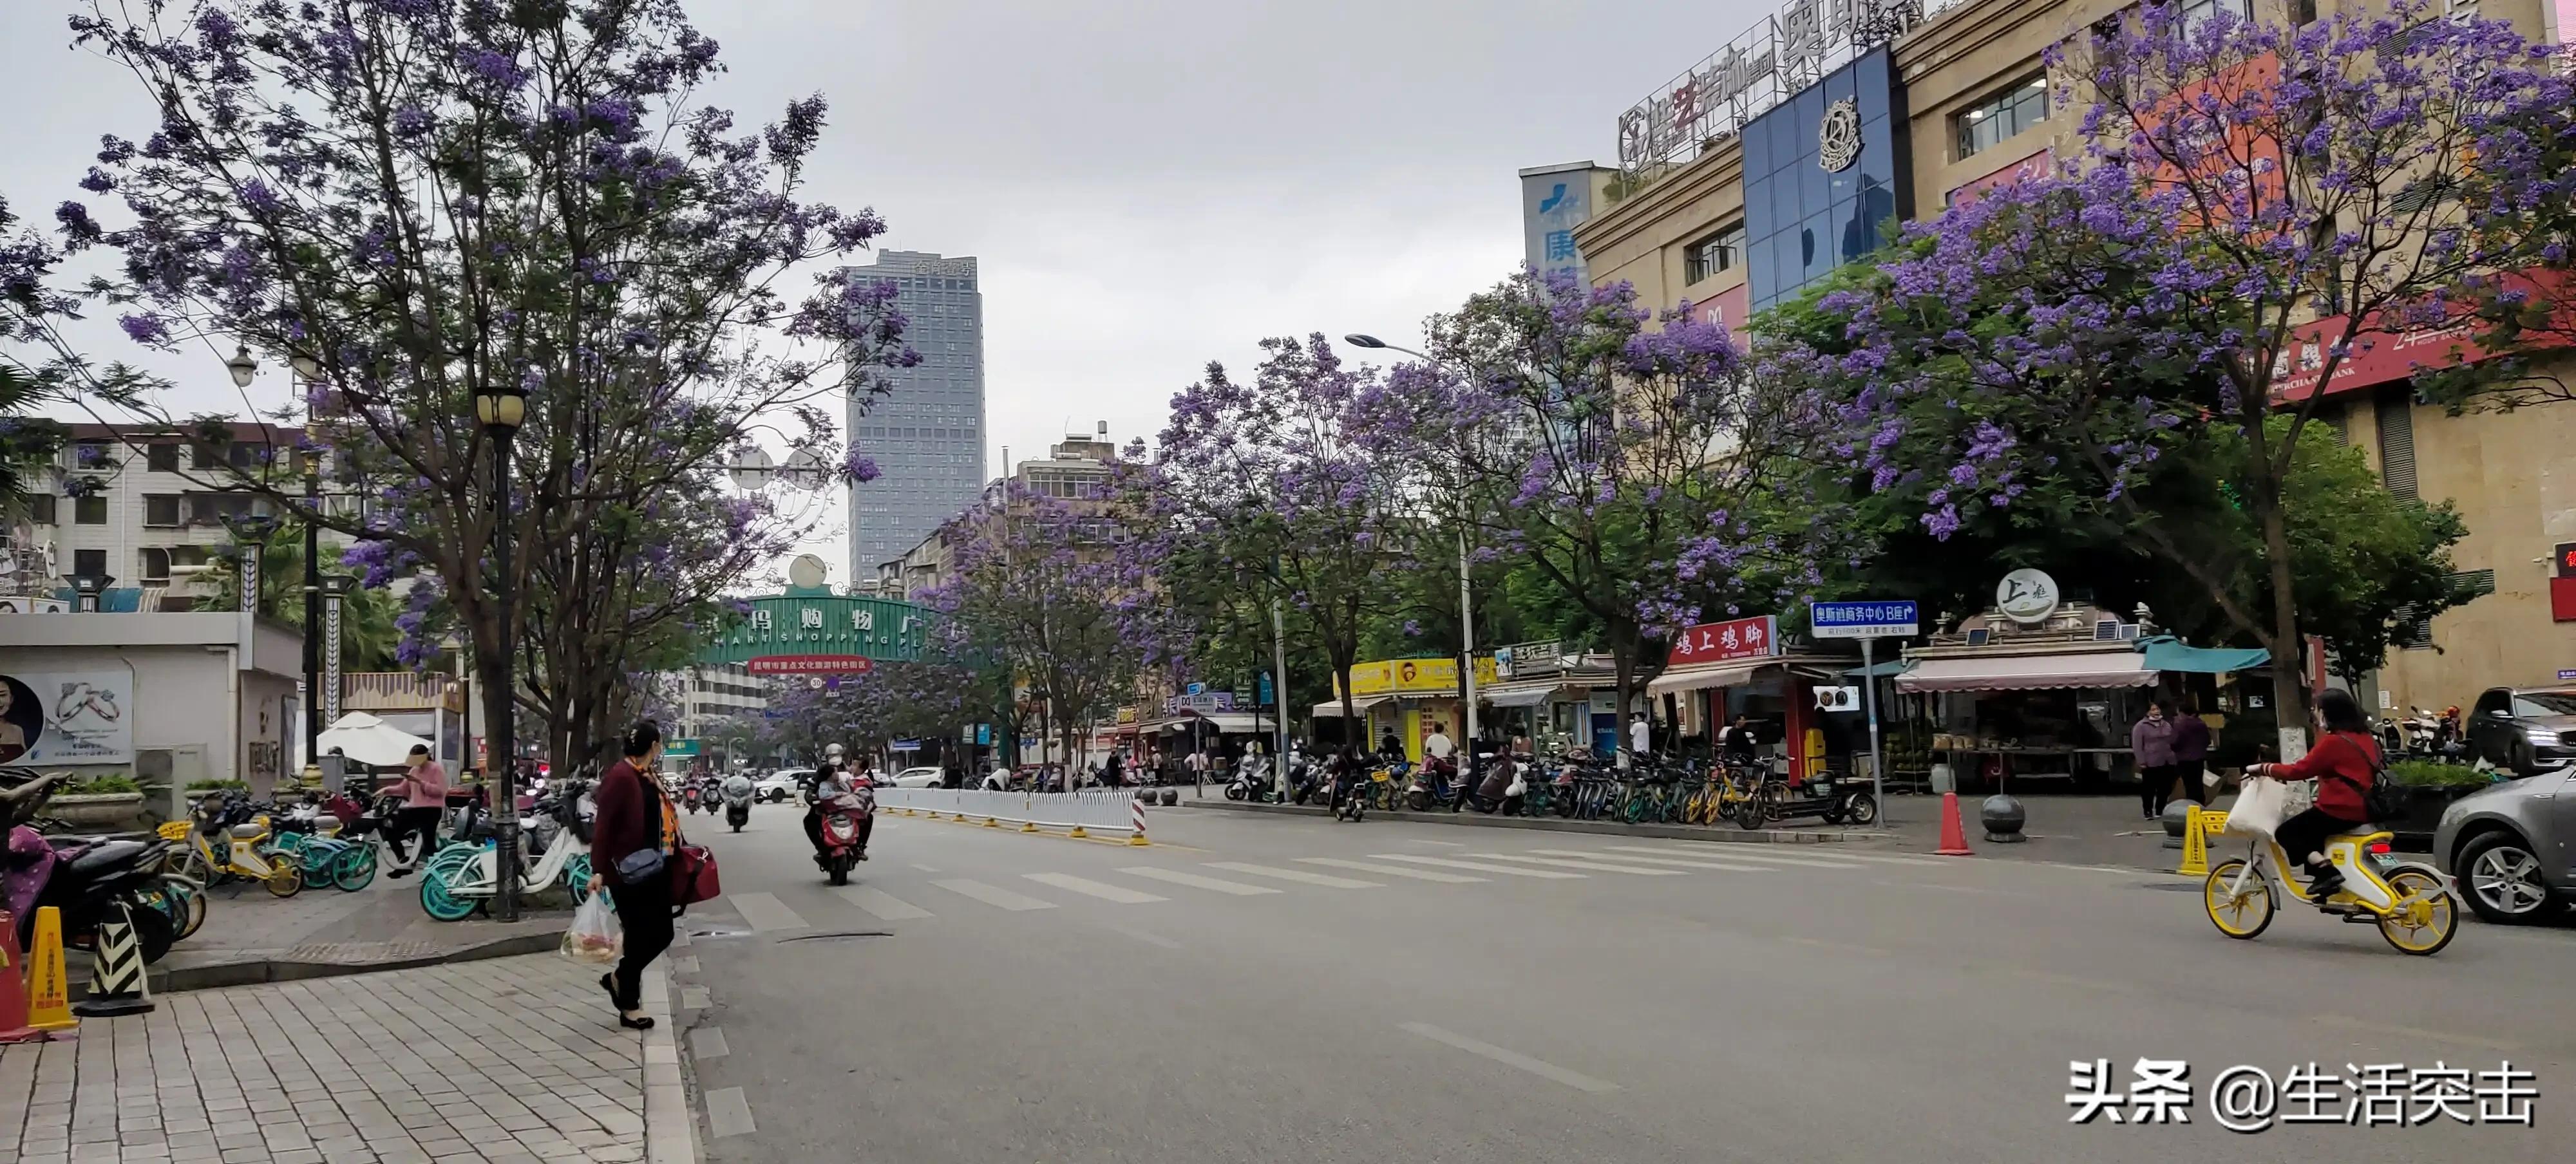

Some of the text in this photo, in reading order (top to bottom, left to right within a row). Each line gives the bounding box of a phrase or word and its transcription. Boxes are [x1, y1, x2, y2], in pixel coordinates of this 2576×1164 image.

[781, 634, 889, 644] SHOPPING
[753, 661, 866, 671] 昆明市重点文化旅游特色街区
